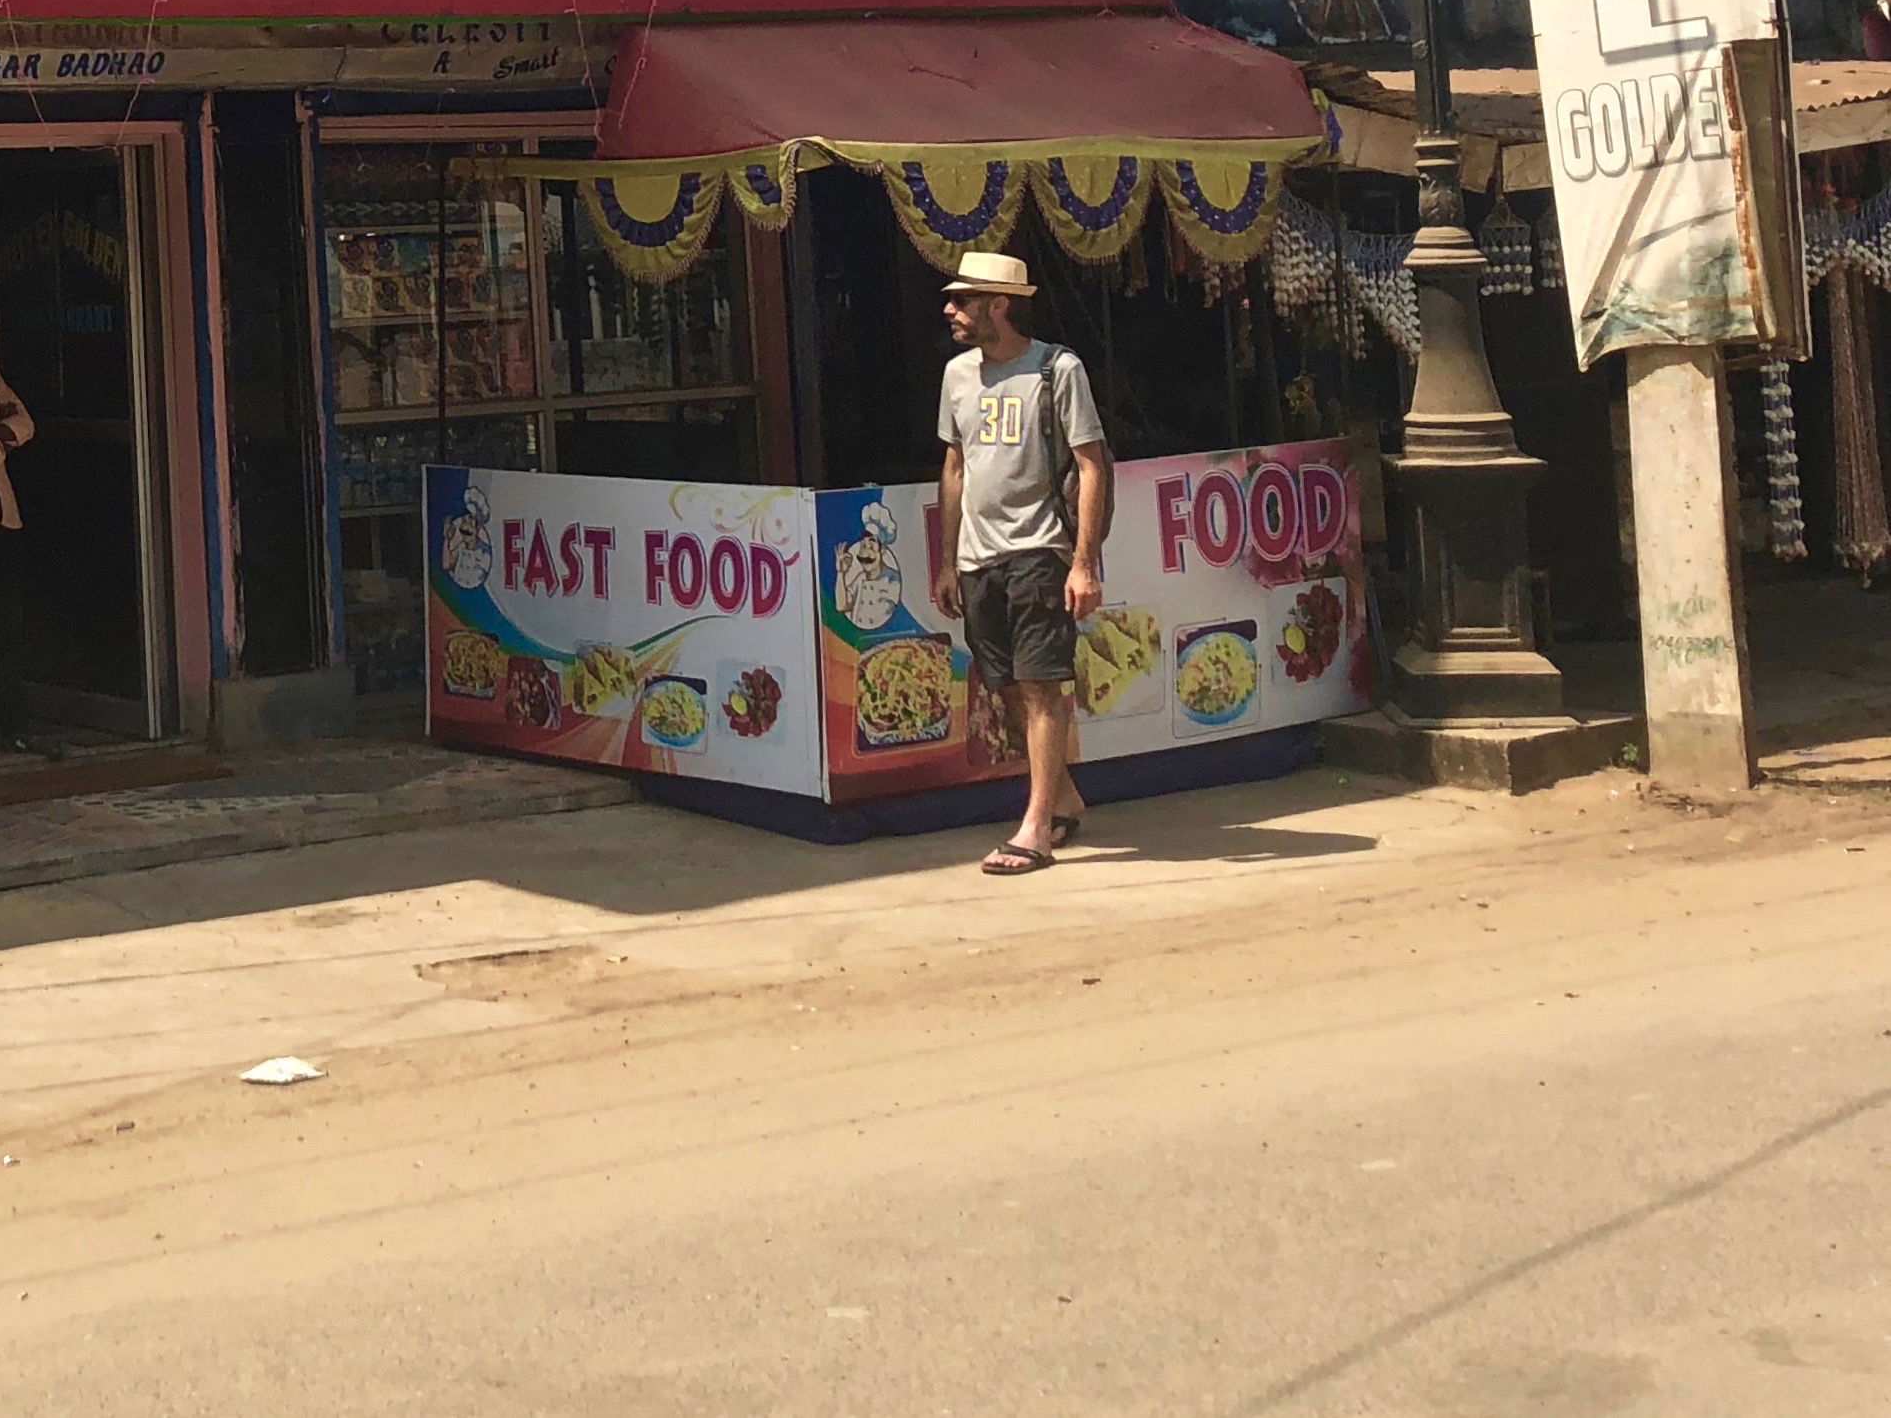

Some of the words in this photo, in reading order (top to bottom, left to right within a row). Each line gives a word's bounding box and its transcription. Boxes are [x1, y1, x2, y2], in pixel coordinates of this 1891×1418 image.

[56, 51, 166, 78] BADHAO
[493, 47, 559, 79] Smart
[1556, 66, 1728, 182] GOLDE
[501, 517, 616, 600] FAST
[643, 528, 789, 619] FOOD
[1154, 462, 1348, 574] FOOD
